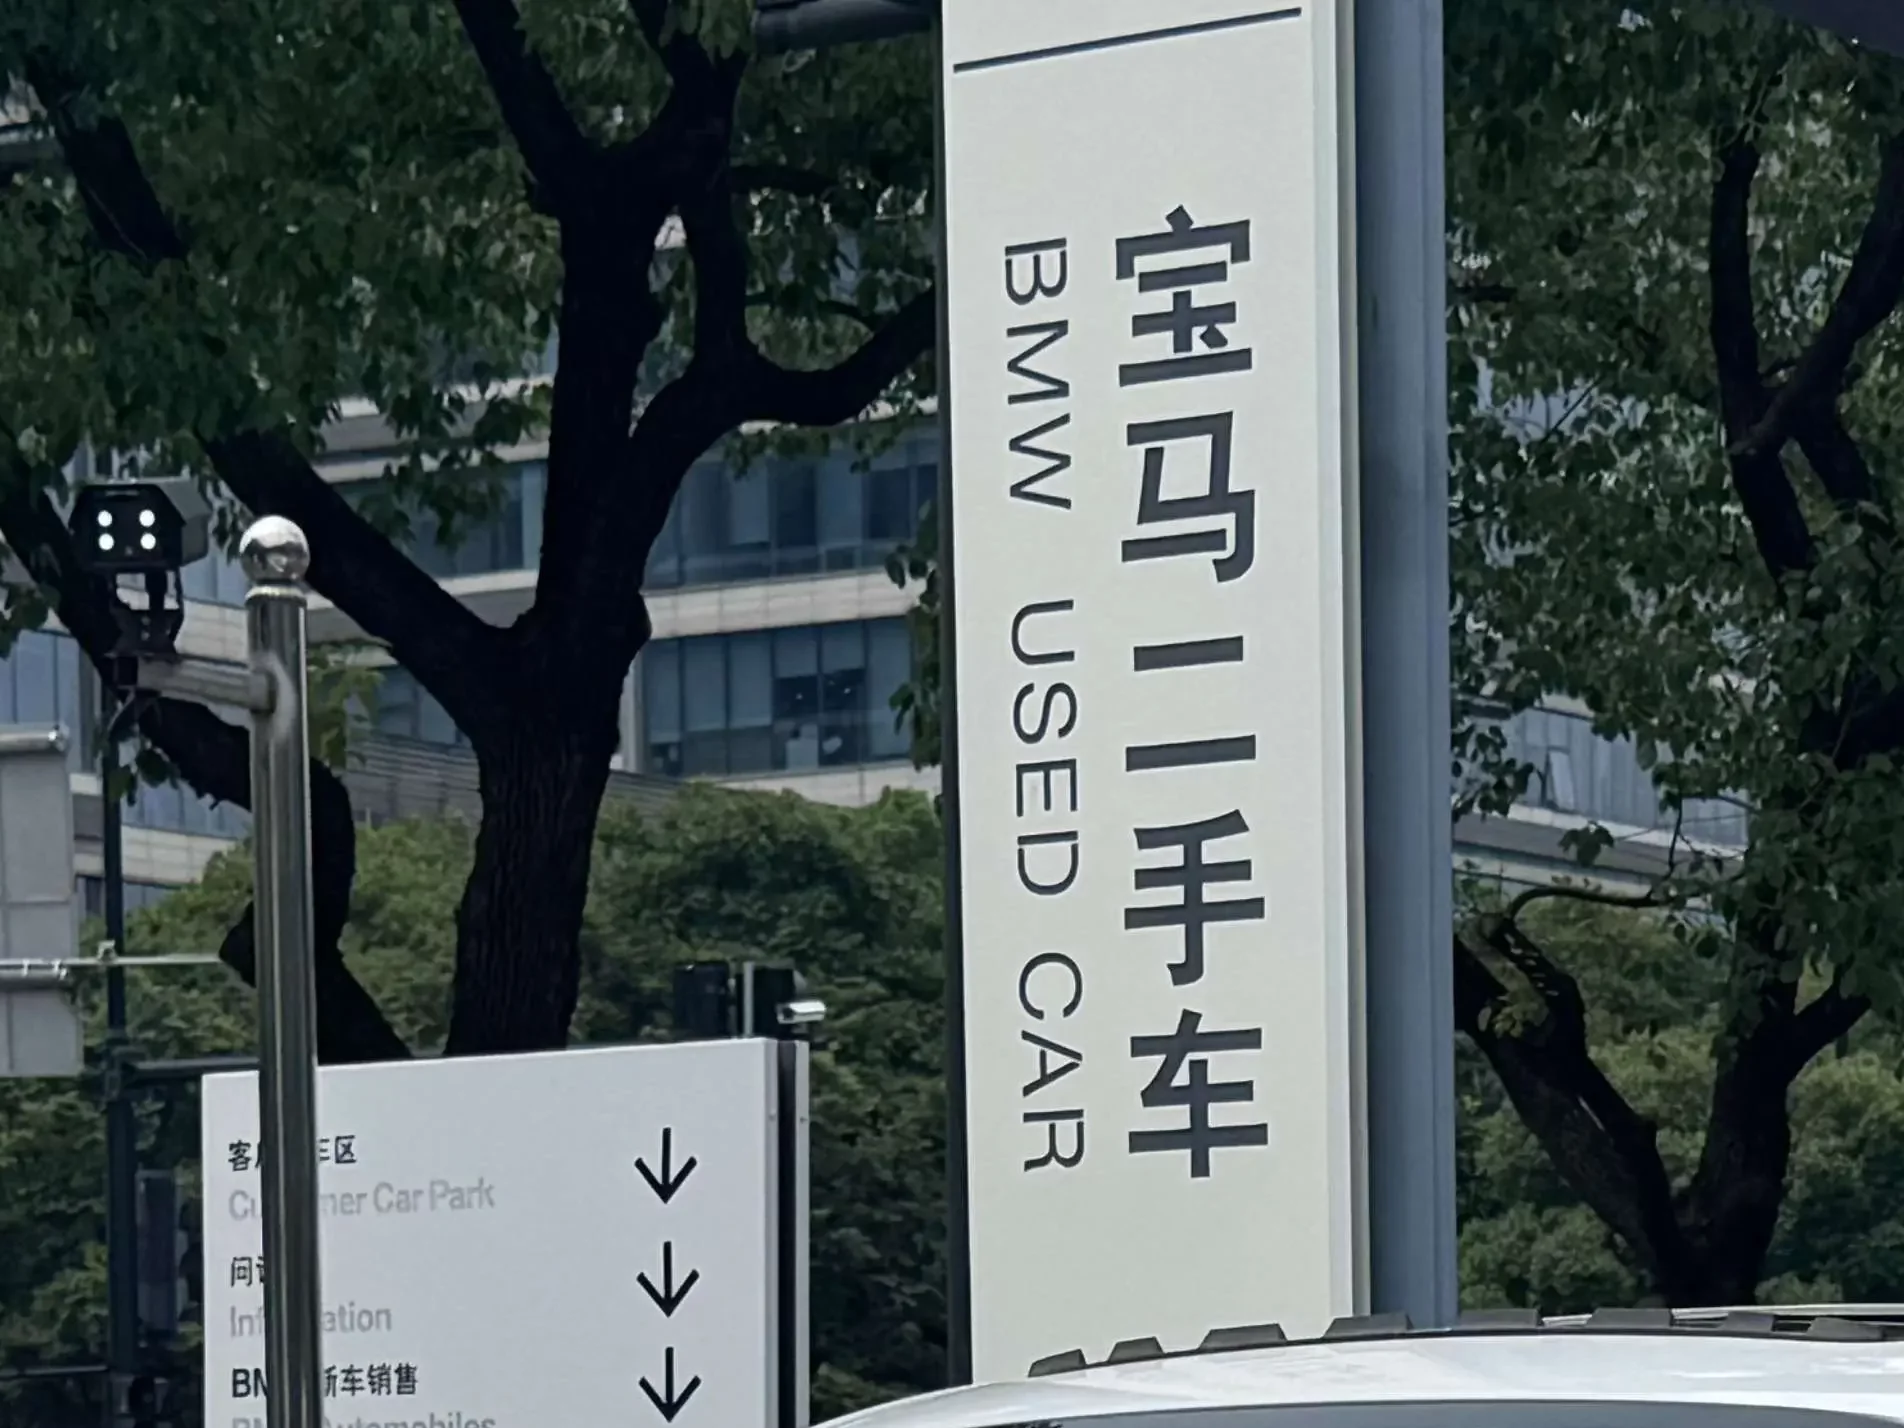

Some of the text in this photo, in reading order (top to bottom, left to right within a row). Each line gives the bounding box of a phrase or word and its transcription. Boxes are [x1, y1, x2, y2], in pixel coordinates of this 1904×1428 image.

[1004, 237, 1085, 1172] BMW USED CAR
[1115, 205, 1269, 1178] 宝马二手车
[373, 1181, 424, 1214] Car
[429, 1176, 496, 1211] Park
